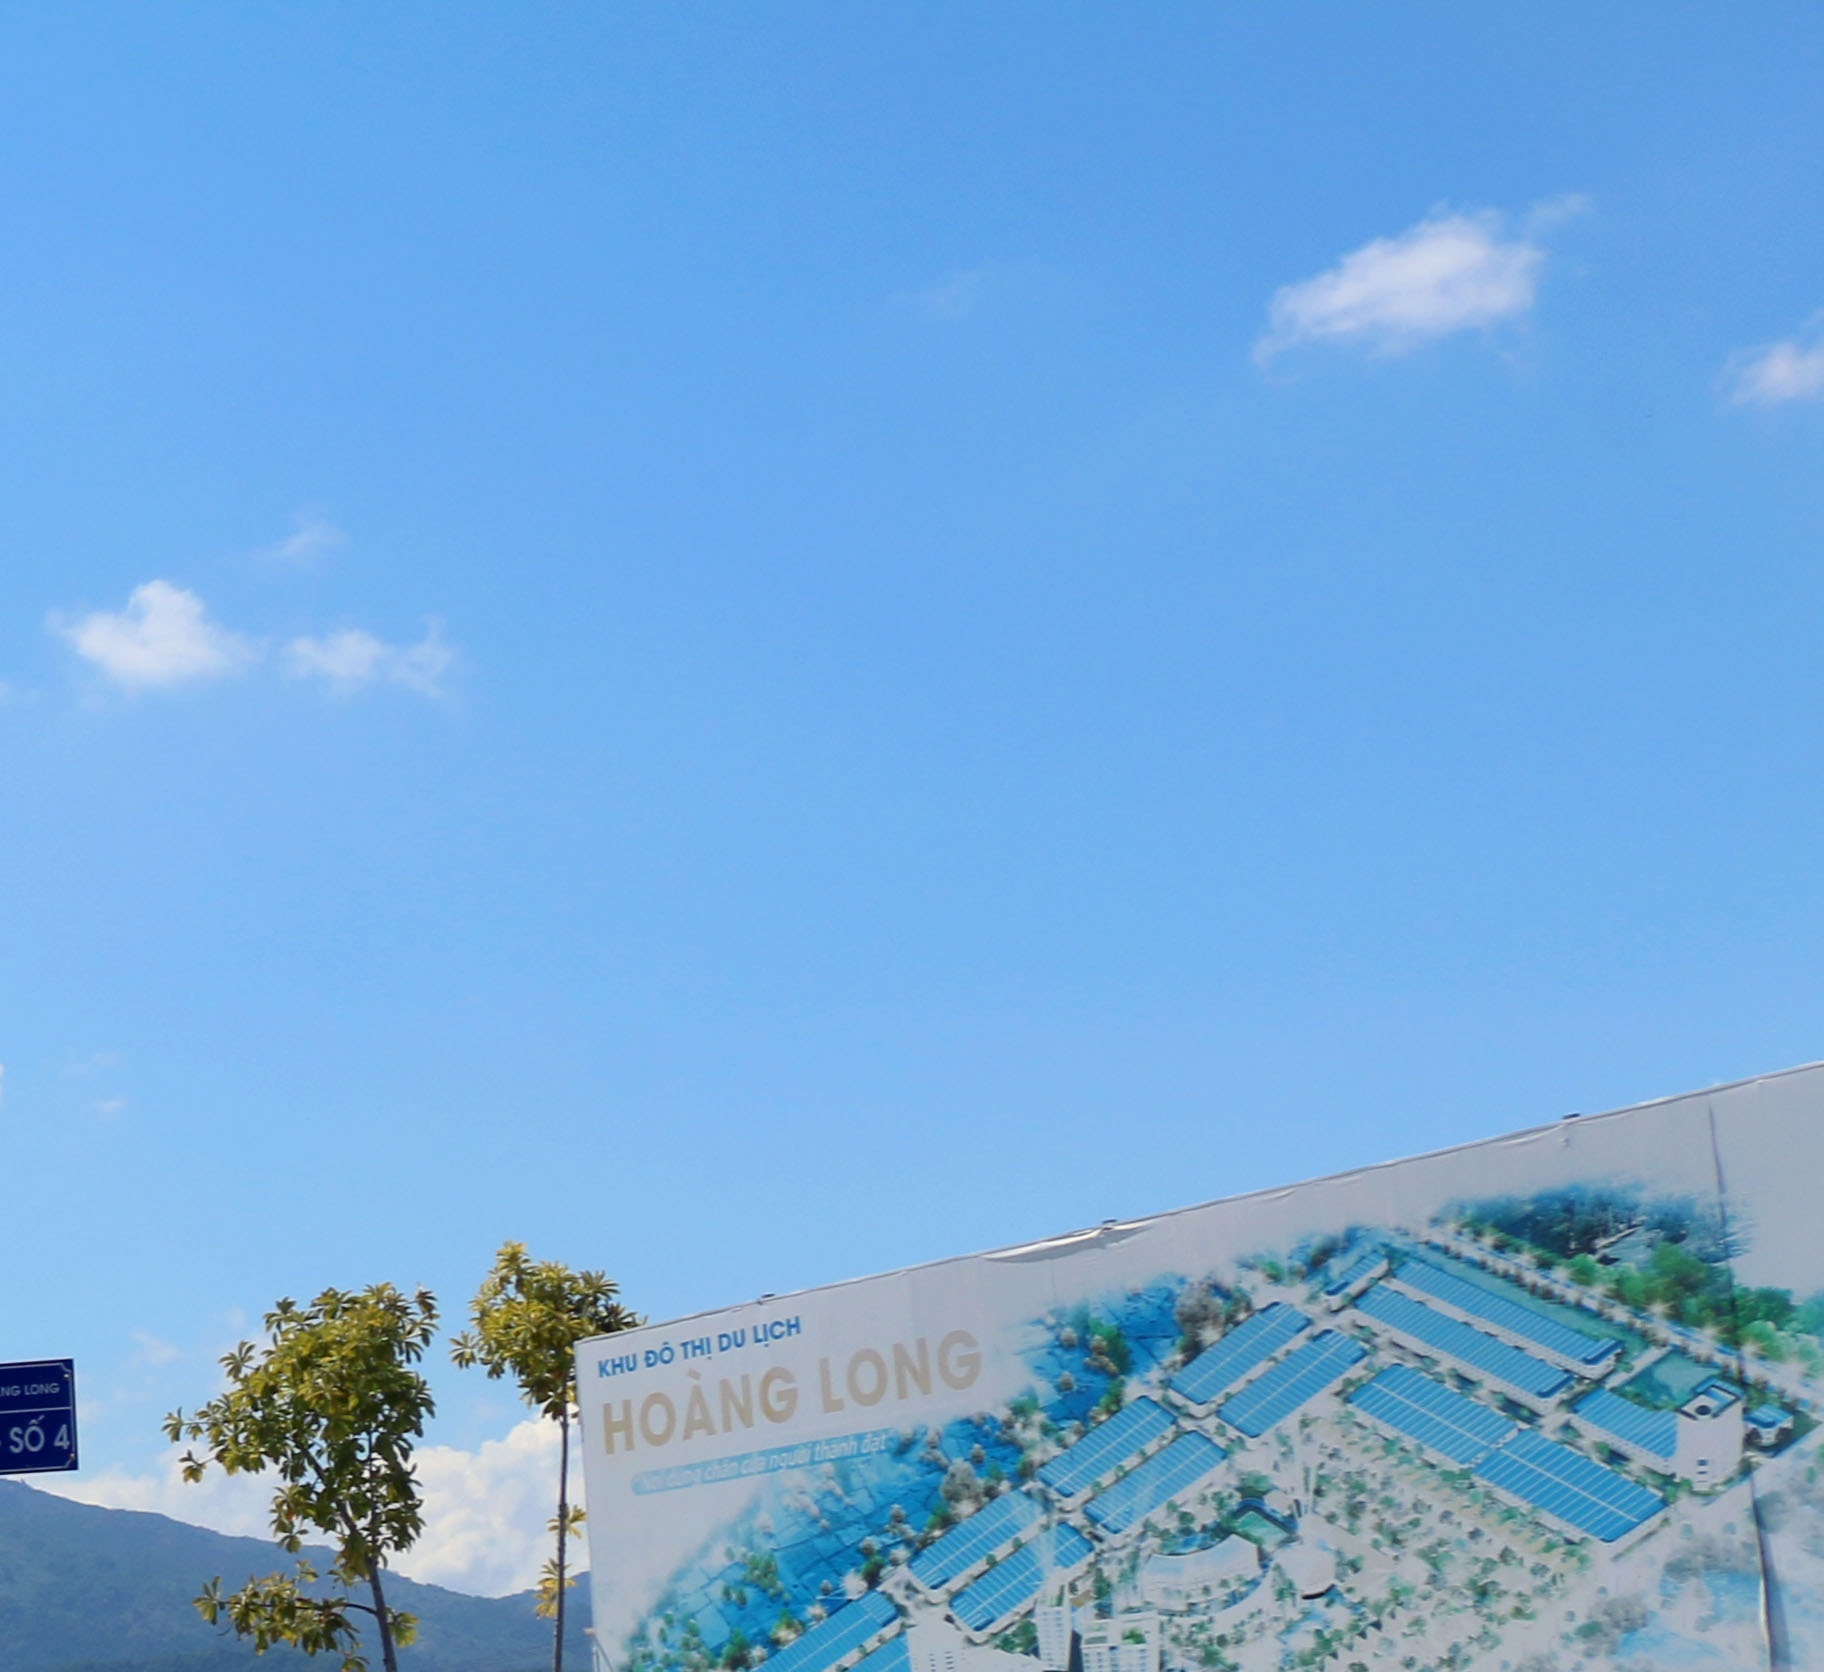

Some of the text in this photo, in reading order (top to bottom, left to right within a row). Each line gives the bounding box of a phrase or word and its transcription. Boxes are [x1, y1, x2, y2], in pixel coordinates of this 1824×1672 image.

[597, 1315, 802, 1379] KHU ĐÔ THỊ DU LỊCH
[24, 1382, 61, 1396] LONG
[602, 1329, 983, 1455] HOÀNG LONG
[9, 1415, 45, 1454] SỐ
[54, 1424, 71, 1450] 4
